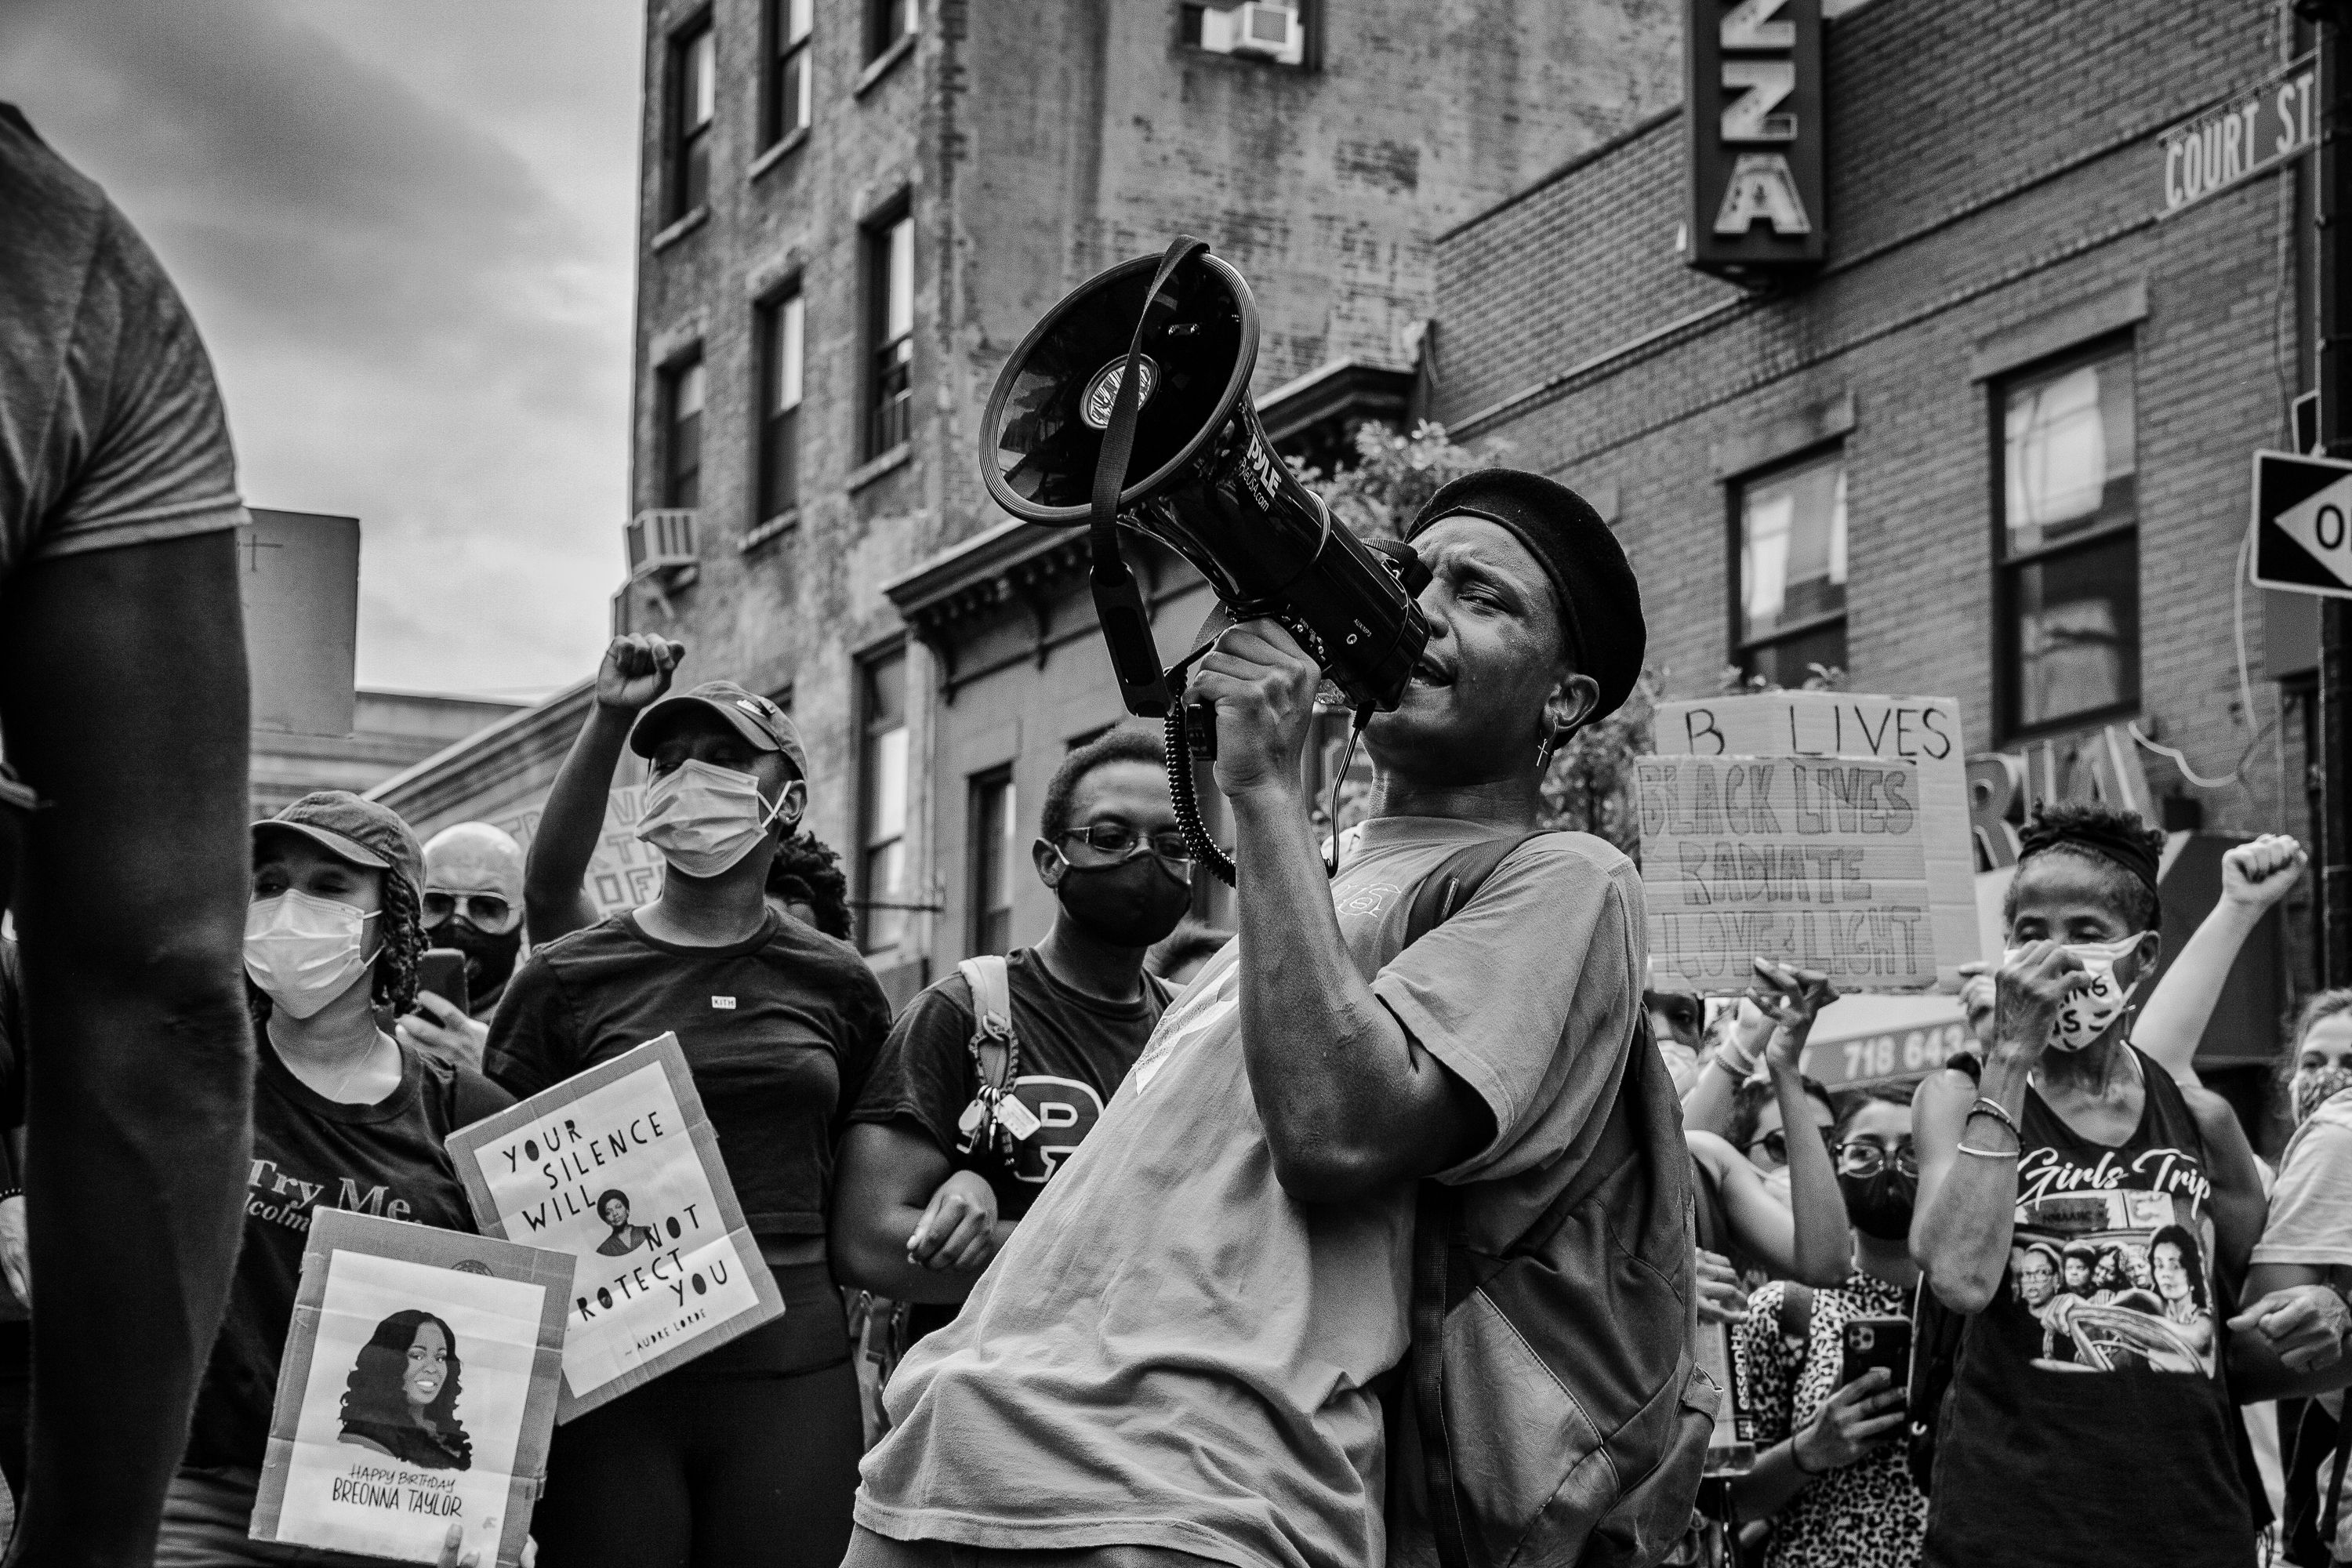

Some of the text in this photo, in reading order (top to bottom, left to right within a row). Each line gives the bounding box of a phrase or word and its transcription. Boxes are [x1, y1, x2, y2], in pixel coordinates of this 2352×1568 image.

[2165, 71, 2314, 208] COURT ST
[2316, 503, 2352, 550] O
[1791, 704, 1951, 759] LIVES
[1638, 764, 1915, 837] BLACK LIVES
[1679, 840, 1872, 906] RADIATE
[1661, 910, 1777, 978] LOVE
[1802, 906, 1922, 976] LIGHT
[1844, 1035, 1896, 1080] 718
[502, 1119, 583, 1174] YOUR
[543, 1111, 664, 1190] SILENCE
[248, 1158, 325, 1210] Try
[521, 1184, 596, 1232] WILL
[2016, 1146, 2211, 1221] Girls Trip
[243, 1192, 311, 1232] lcolm
[644, 1203, 702, 1252] NOT
[576, 1248, 684, 1322] ROTECT
[669, 1260, 728, 1307] YOU
[636, 1307, 707, 1354] AUDRE LORDE
[332, 1476, 463, 1518] BREONNA TAYLOR
[348, 1462, 456, 1494] HAPPY BIRTHDAY
